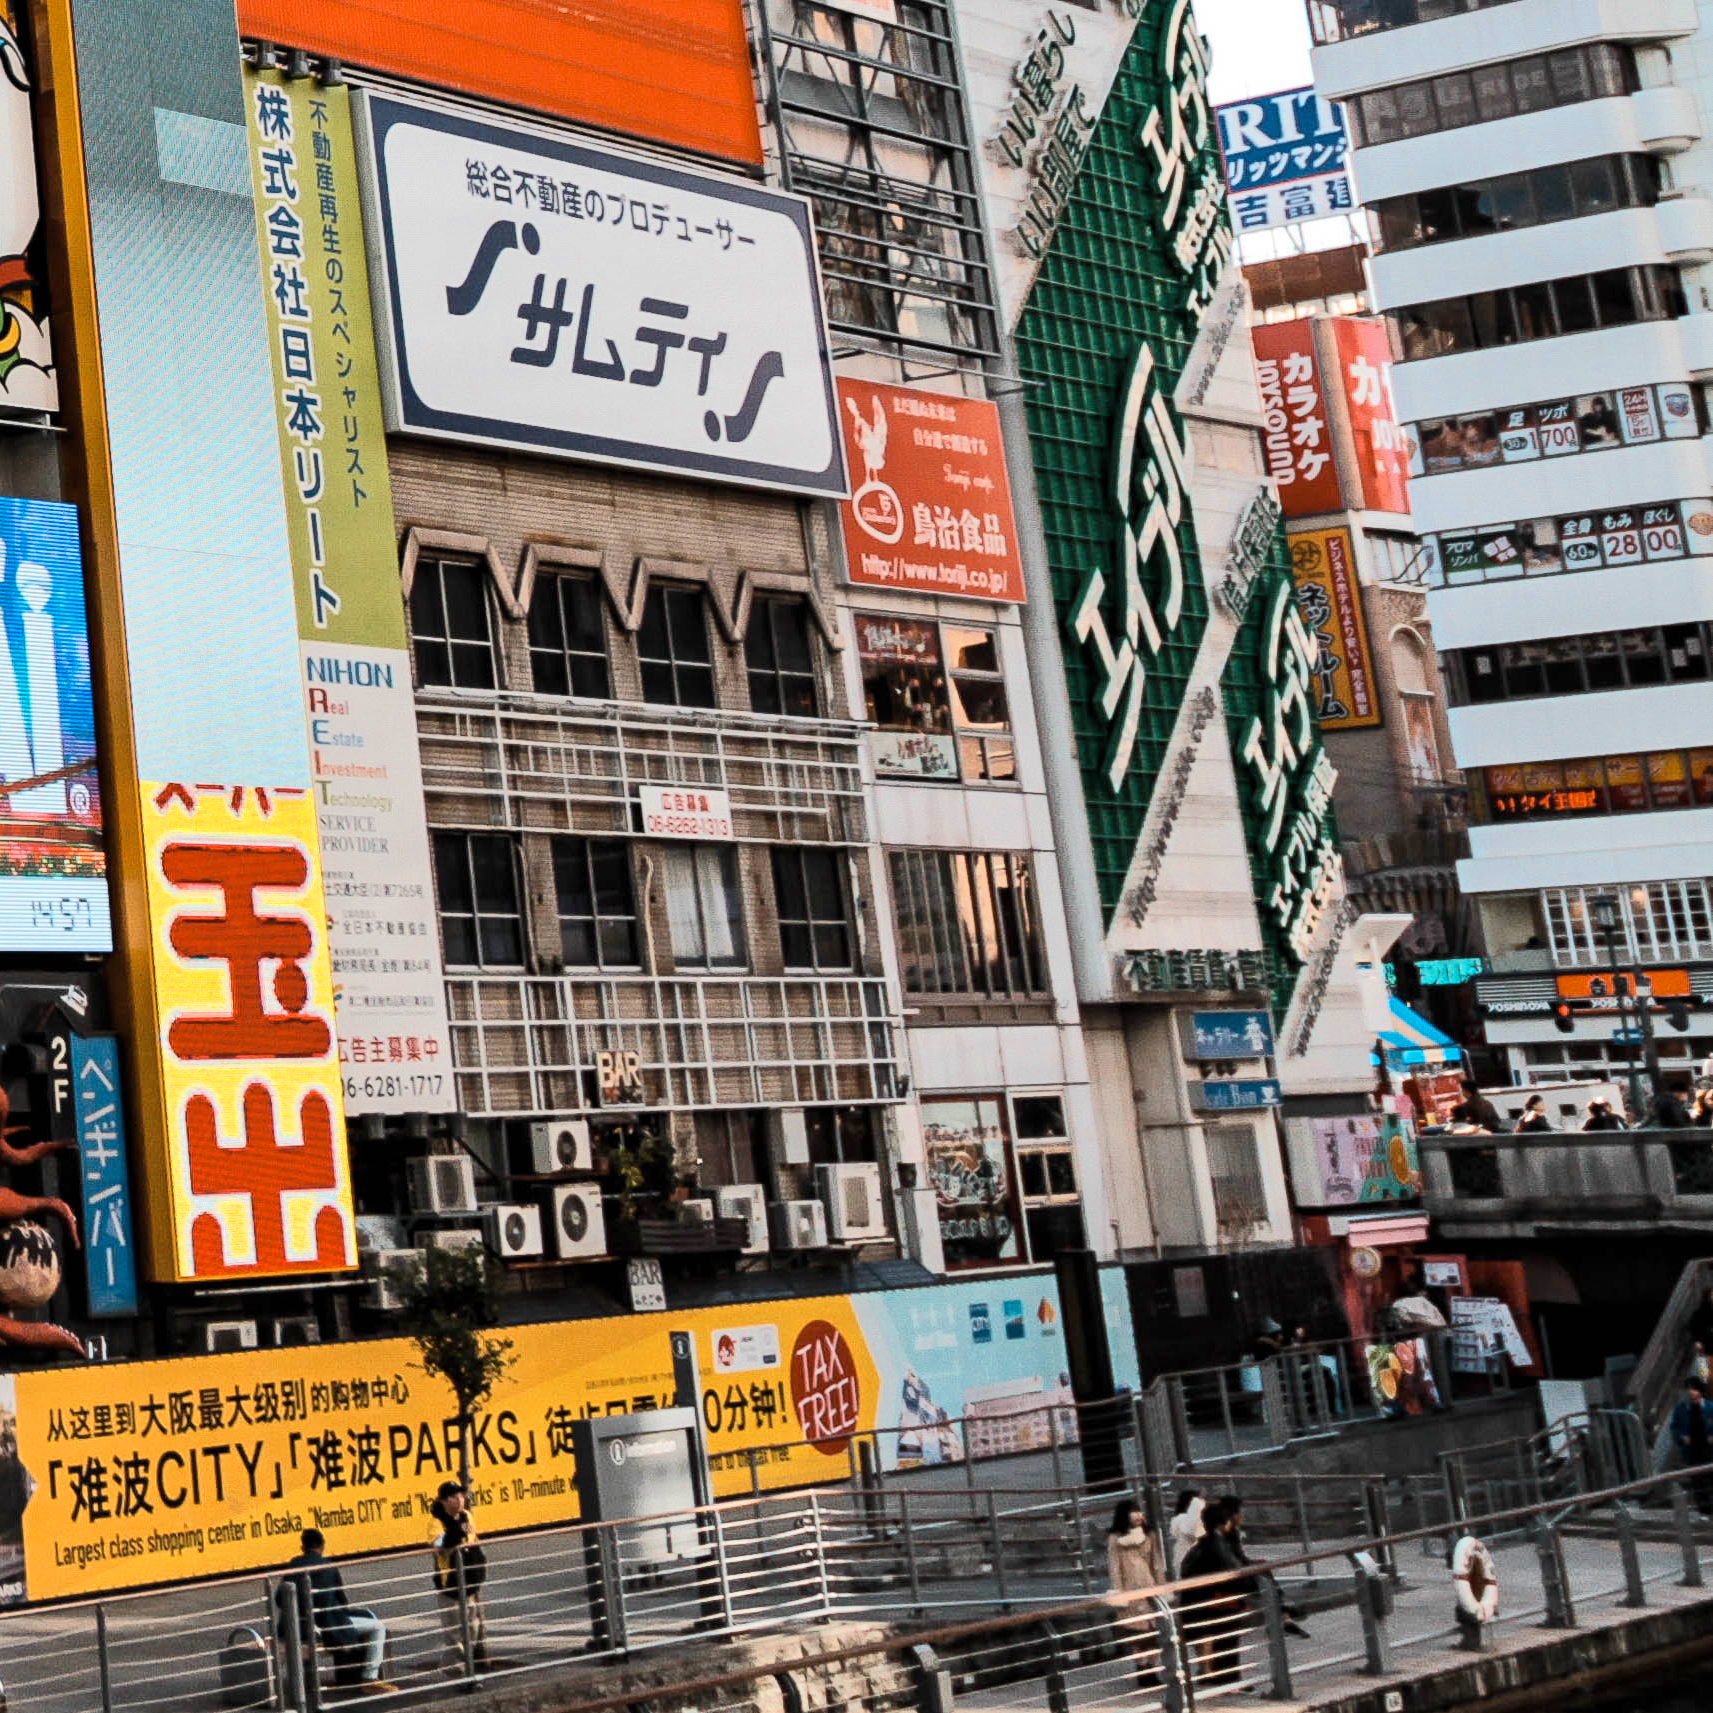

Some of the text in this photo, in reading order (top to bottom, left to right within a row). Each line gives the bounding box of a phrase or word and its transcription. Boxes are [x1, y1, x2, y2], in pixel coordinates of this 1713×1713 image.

[998, 8, 1077, 168] いい暮らし
[464, 157, 756, 252] 総合不動産のプロデューサー
[308, 99, 368, 509] 不動産再生のスペシャリスト
[509, 273, 728, 398] サムティ
[254, 83, 341, 628] 株式会社日本リート
[1282, 352, 1331, 481] カラオケ
[1075, 341, 1194, 794] エイブル
[306, 656, 394, 688] NIHON
[308, 687, 350, 715] Real
[311, 719, 365, 748] Estate
[1243, 580, 1317, 854] エイブル
[314, 750, 389, 779] Investment
[316, 780, 393, 812] Technology
[320, 815, 376, 833] SERVICE
[321, 836, 390, 855] PROVIDER
[161, 840, 349, 1276] 玉出
[597, 1050, 642, 1088] BAR
[77, 1054, 129, 1288] ペンギンバー
[628, 1258, 664, 1287] BAR
[794, 1329, 842, 1393] TAX
[47, 1372, 411, 1443] 从这里到大阪最大级别的购物中心
[796, 1374, 860, 1442] FREE!
[54, 1534, 106, 1571] Largest
[109, 1534, 145, 1559] class
[147, 1523, 205, 1560] shopping
[208, 1521, 247, 1547] center
[250, 1516, 263, 1540] in
[391, 1494, 412, 1520] and
[498, 1481, 511, 1503] is
